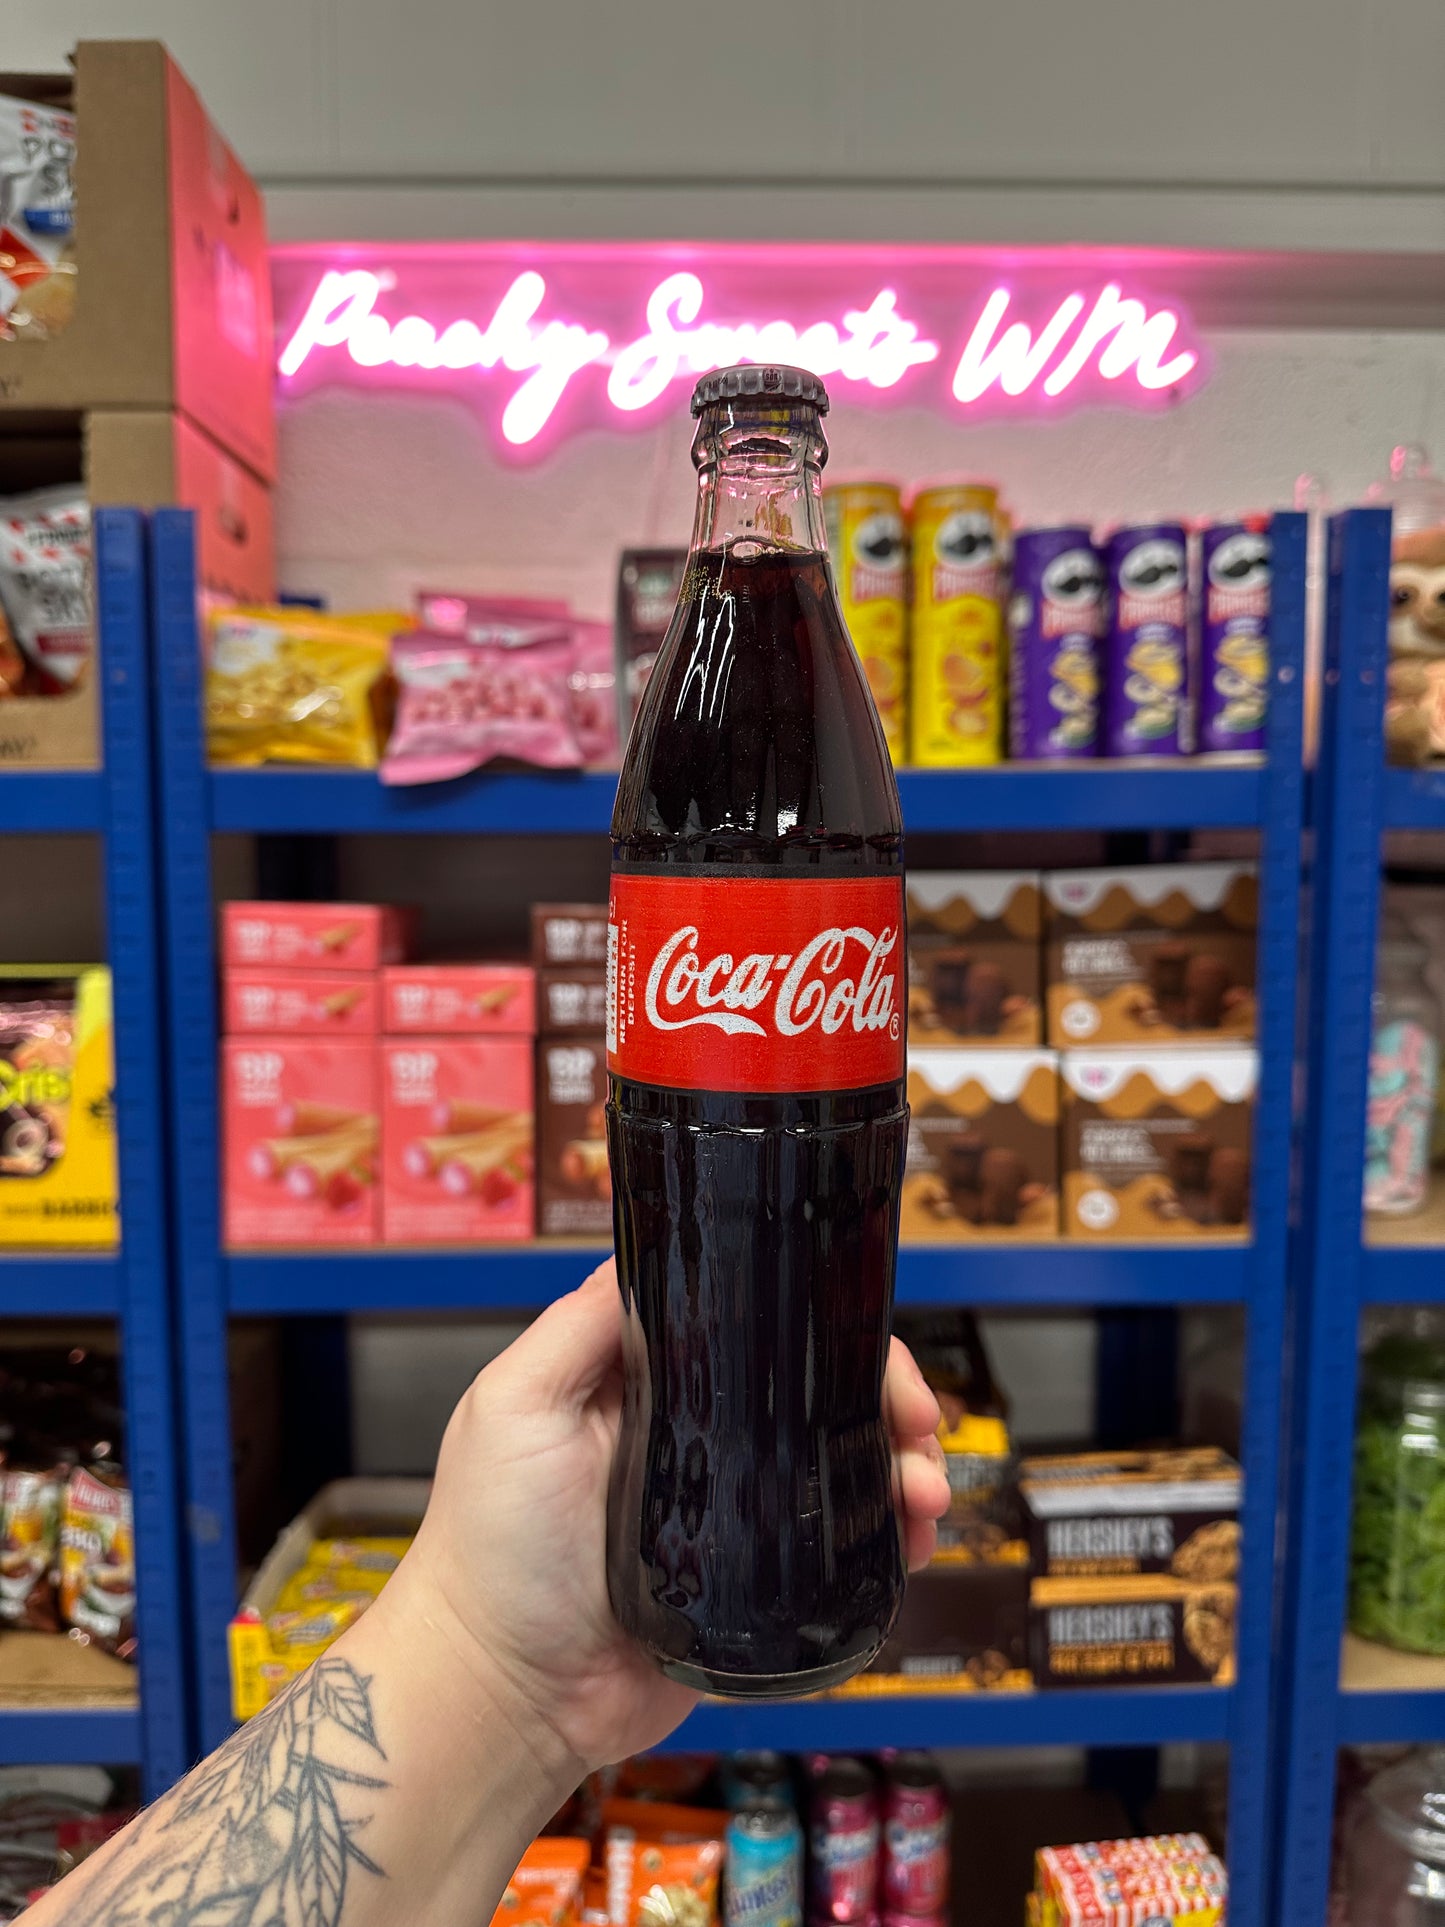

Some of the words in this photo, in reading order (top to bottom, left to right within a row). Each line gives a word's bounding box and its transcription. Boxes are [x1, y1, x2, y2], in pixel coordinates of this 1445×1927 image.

[620, 919, 628, 958] FOR
[619, 964, 627, 1044] RETURN
[627, 944, 636, 1026] DEPOSIT
[645, 925, 898, 1037] Coca-Cola
